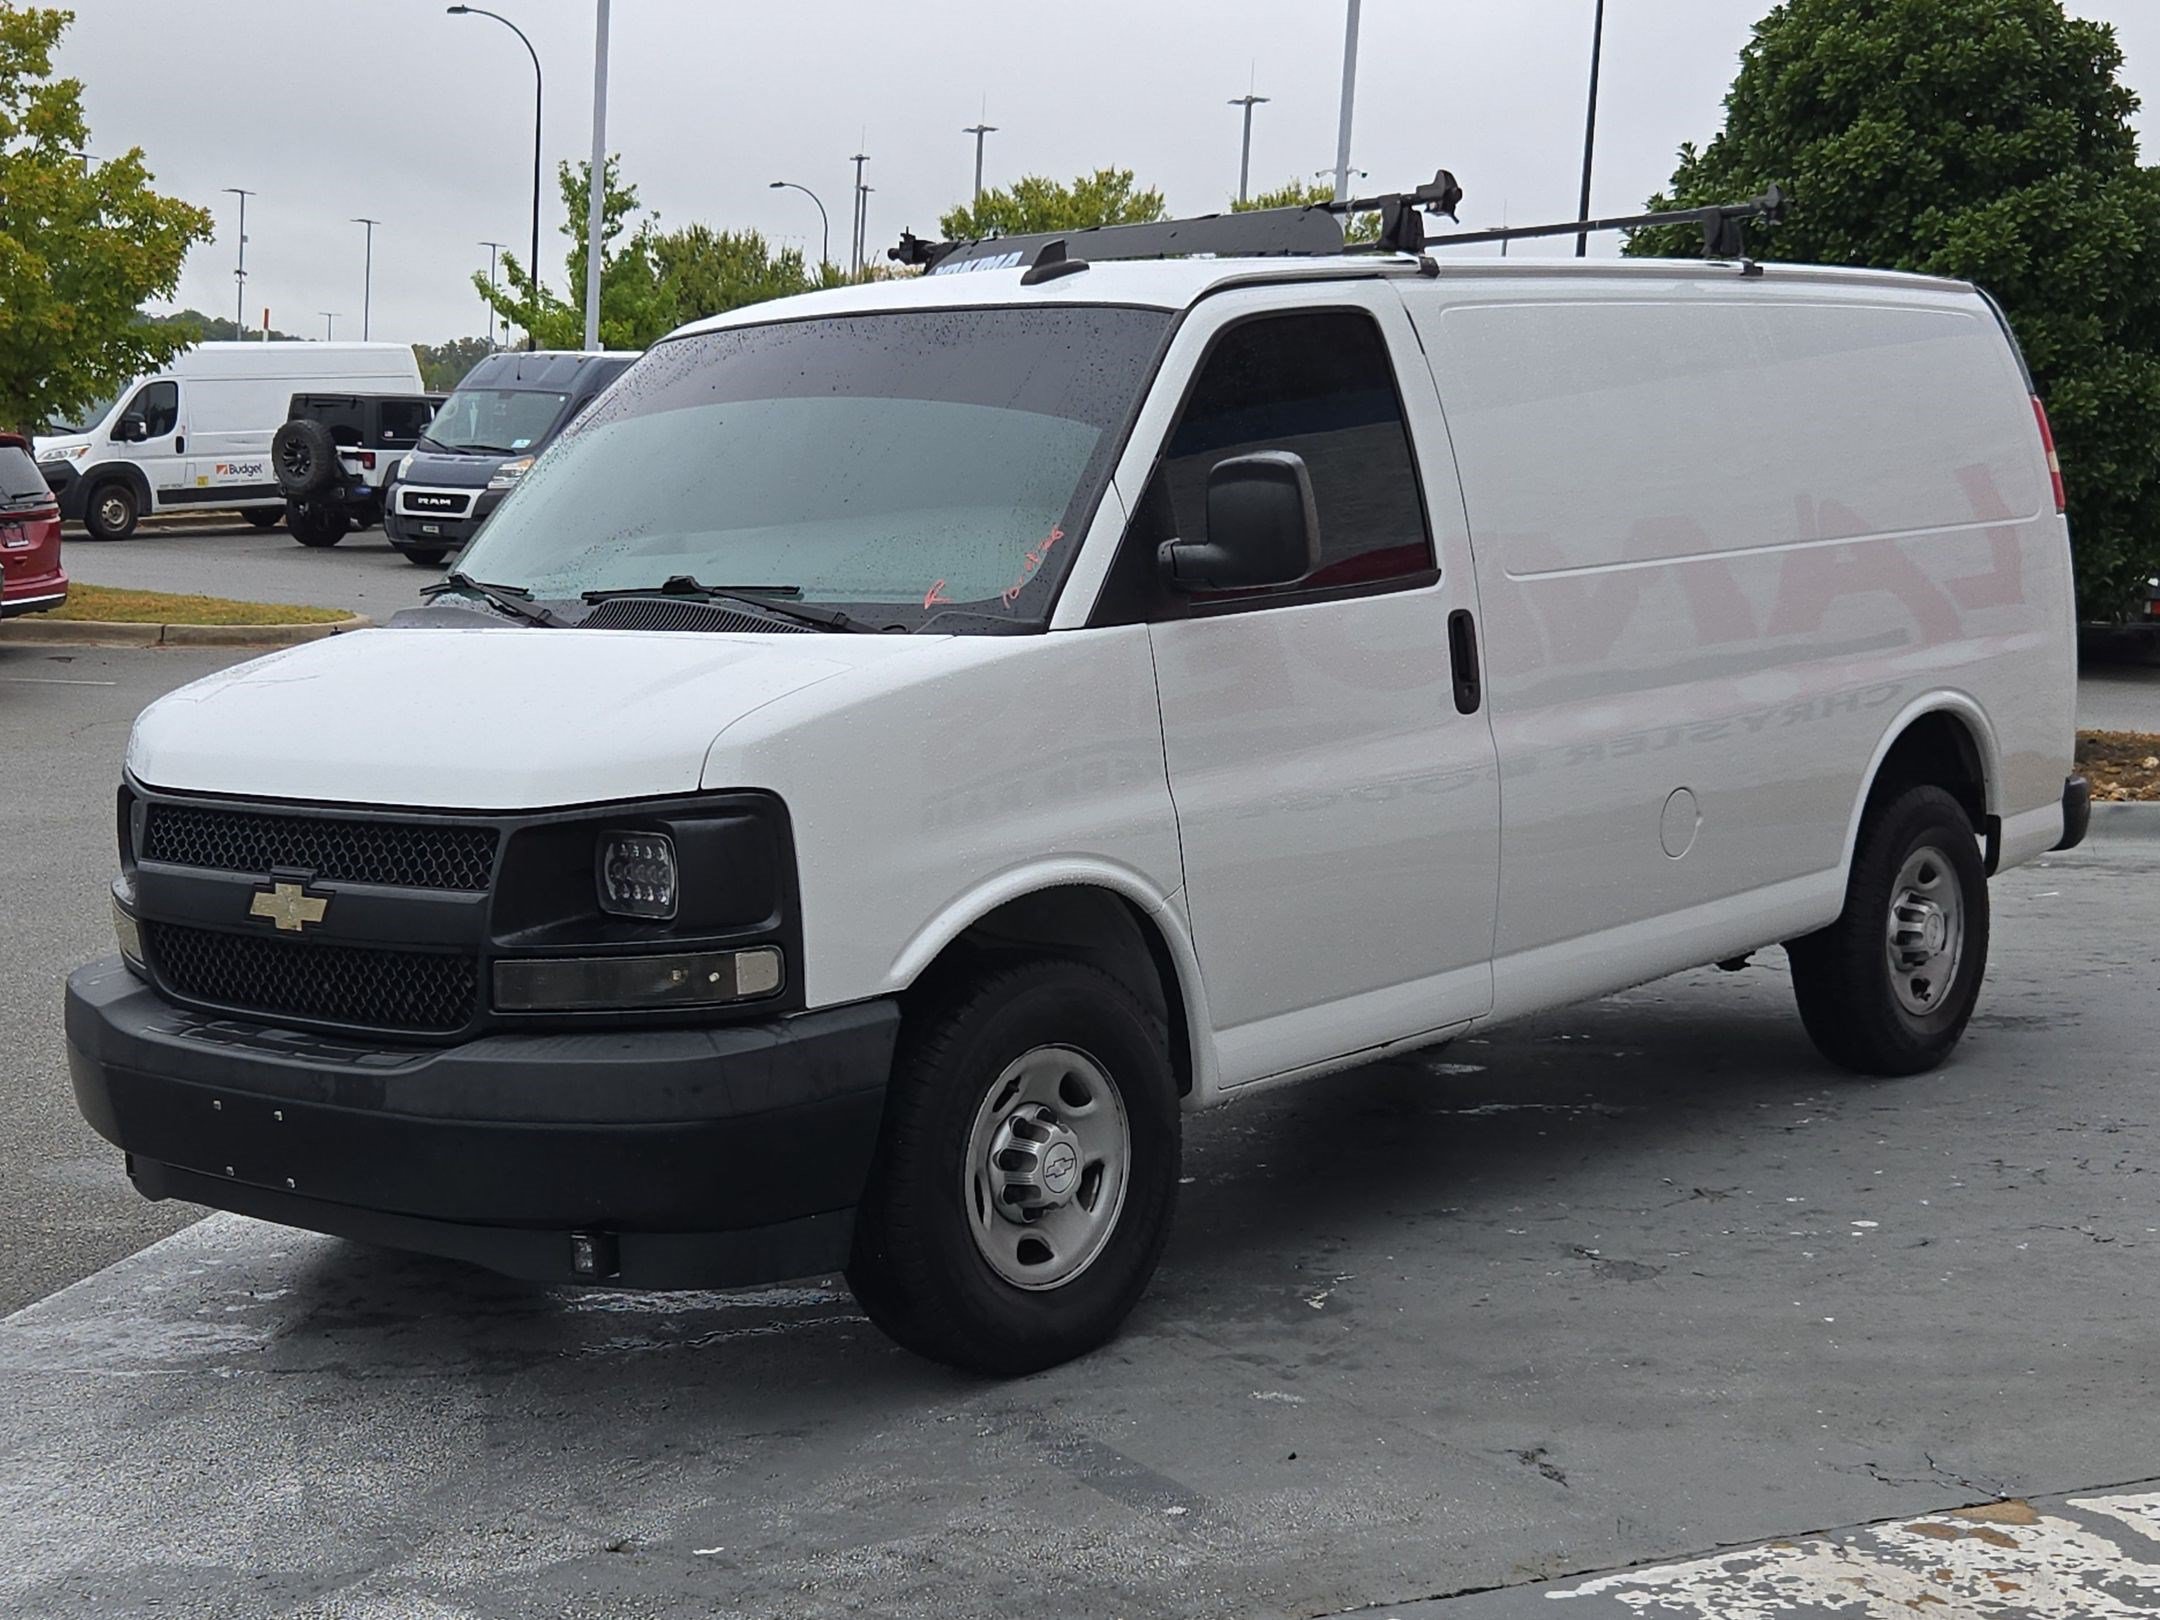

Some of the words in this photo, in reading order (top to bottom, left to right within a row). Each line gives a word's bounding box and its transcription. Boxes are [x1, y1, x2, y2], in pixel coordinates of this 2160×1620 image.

[934, 251, 1024, 276] YAKIMA
[228, 464, 263, 477] Budget
[417, 497, 452, 506] RAM
